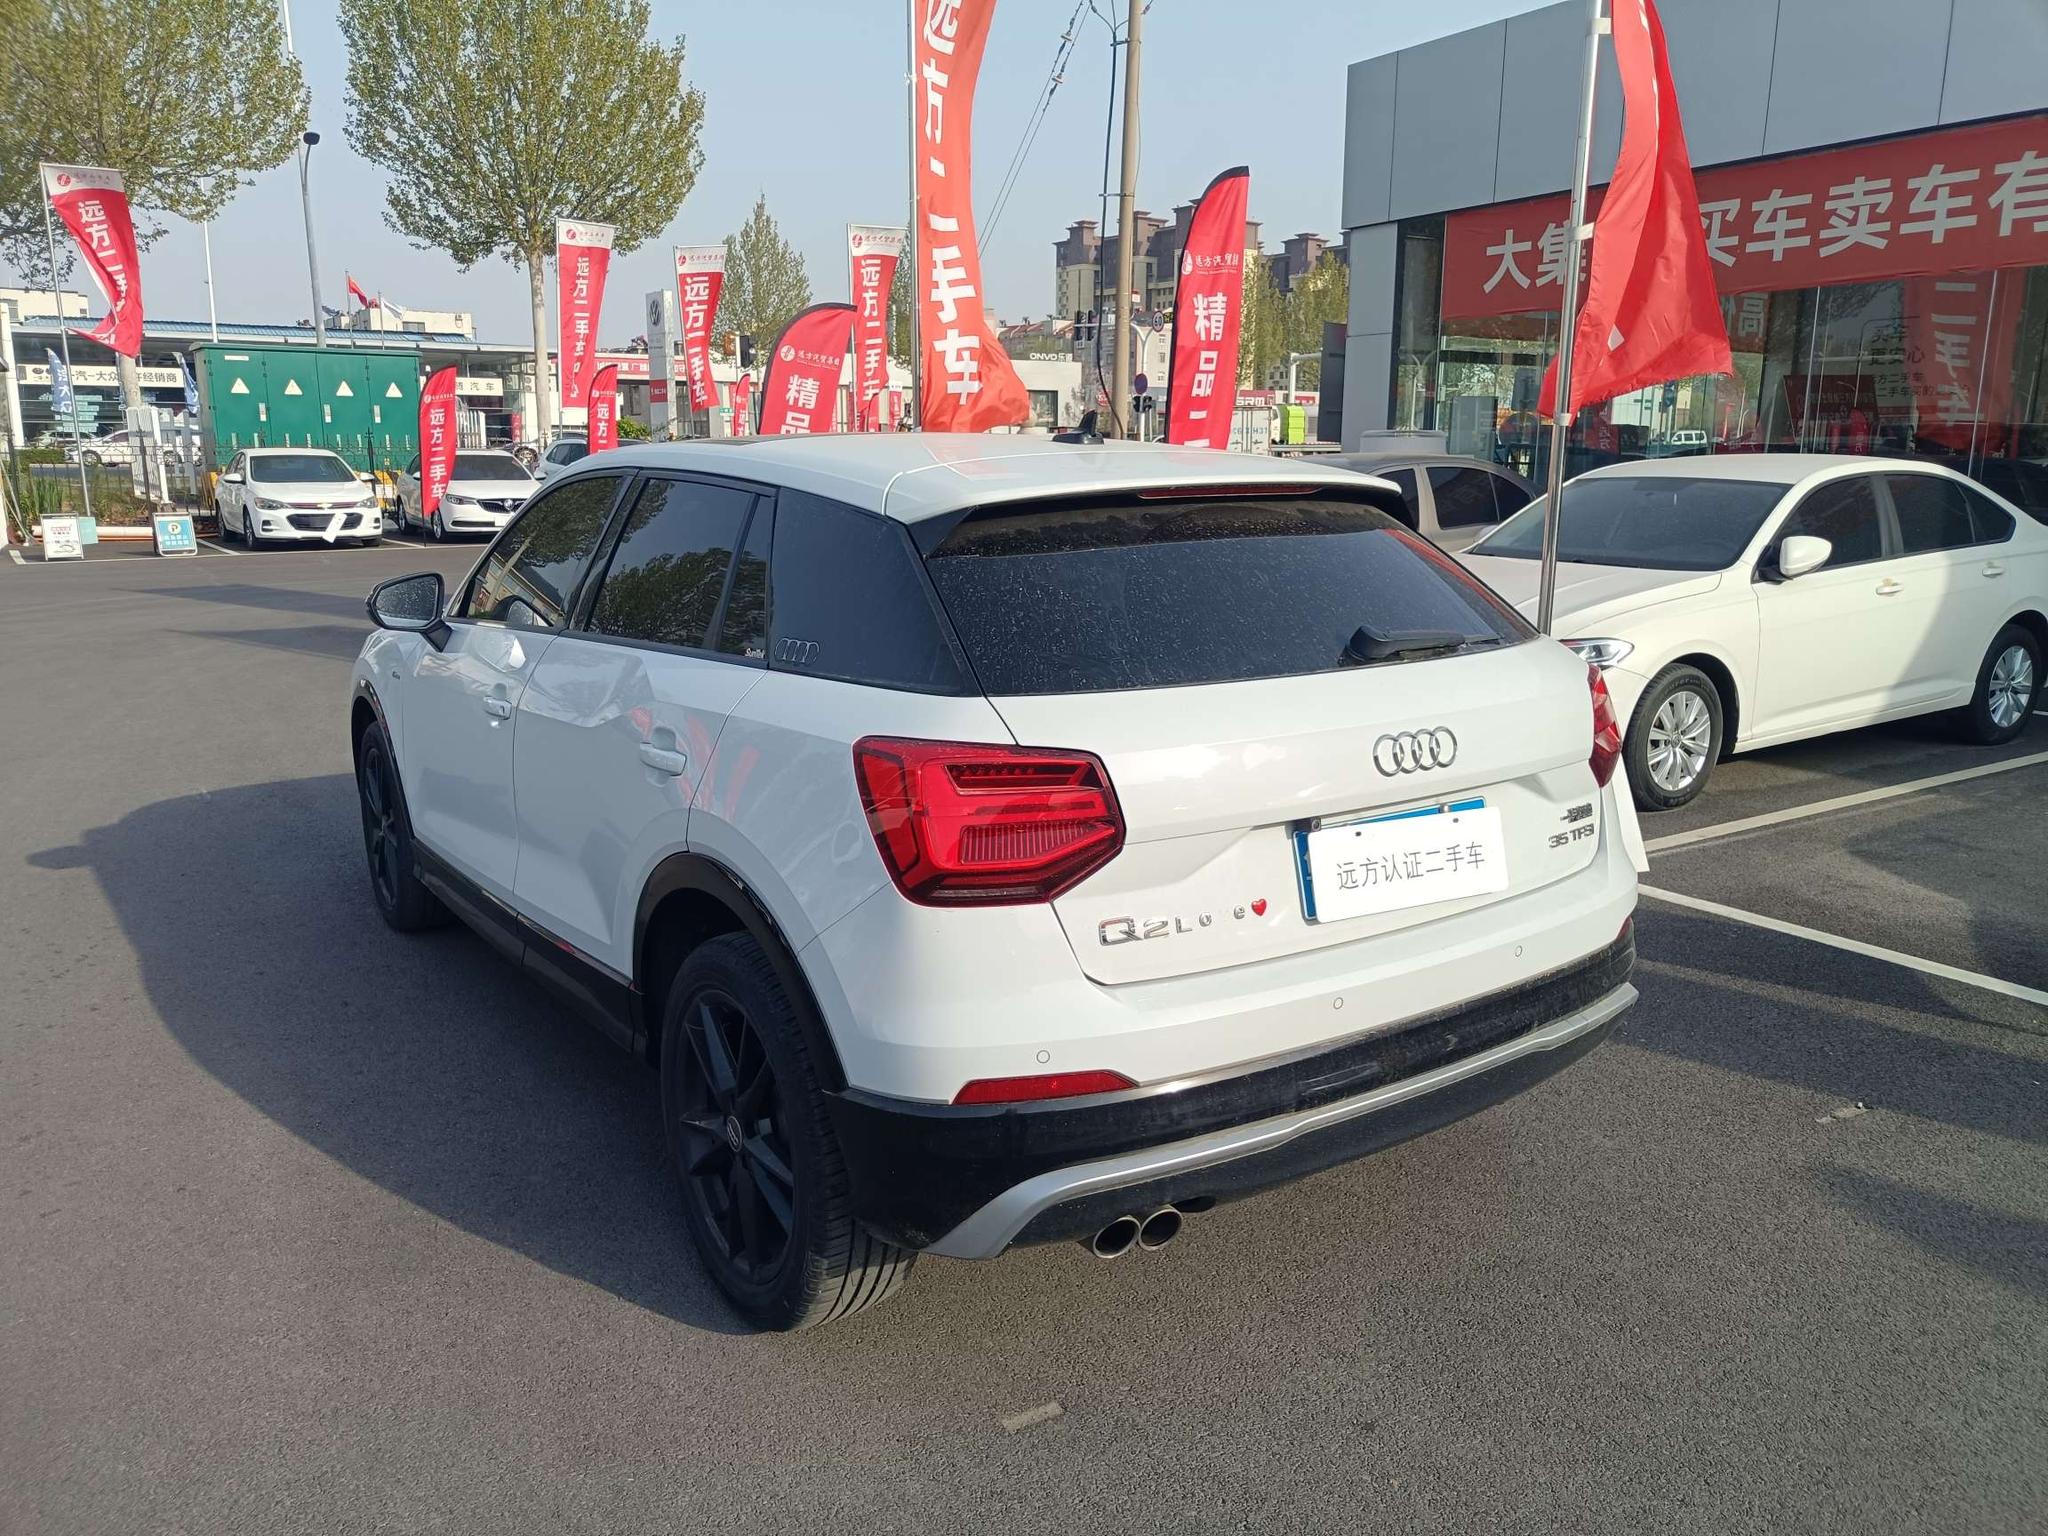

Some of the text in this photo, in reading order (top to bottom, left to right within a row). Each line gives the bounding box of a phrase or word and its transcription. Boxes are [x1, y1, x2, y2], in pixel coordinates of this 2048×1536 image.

[1548, 832, 1569, 849] 35
[1336, 841, 1485, 890] 远方认证二手车
